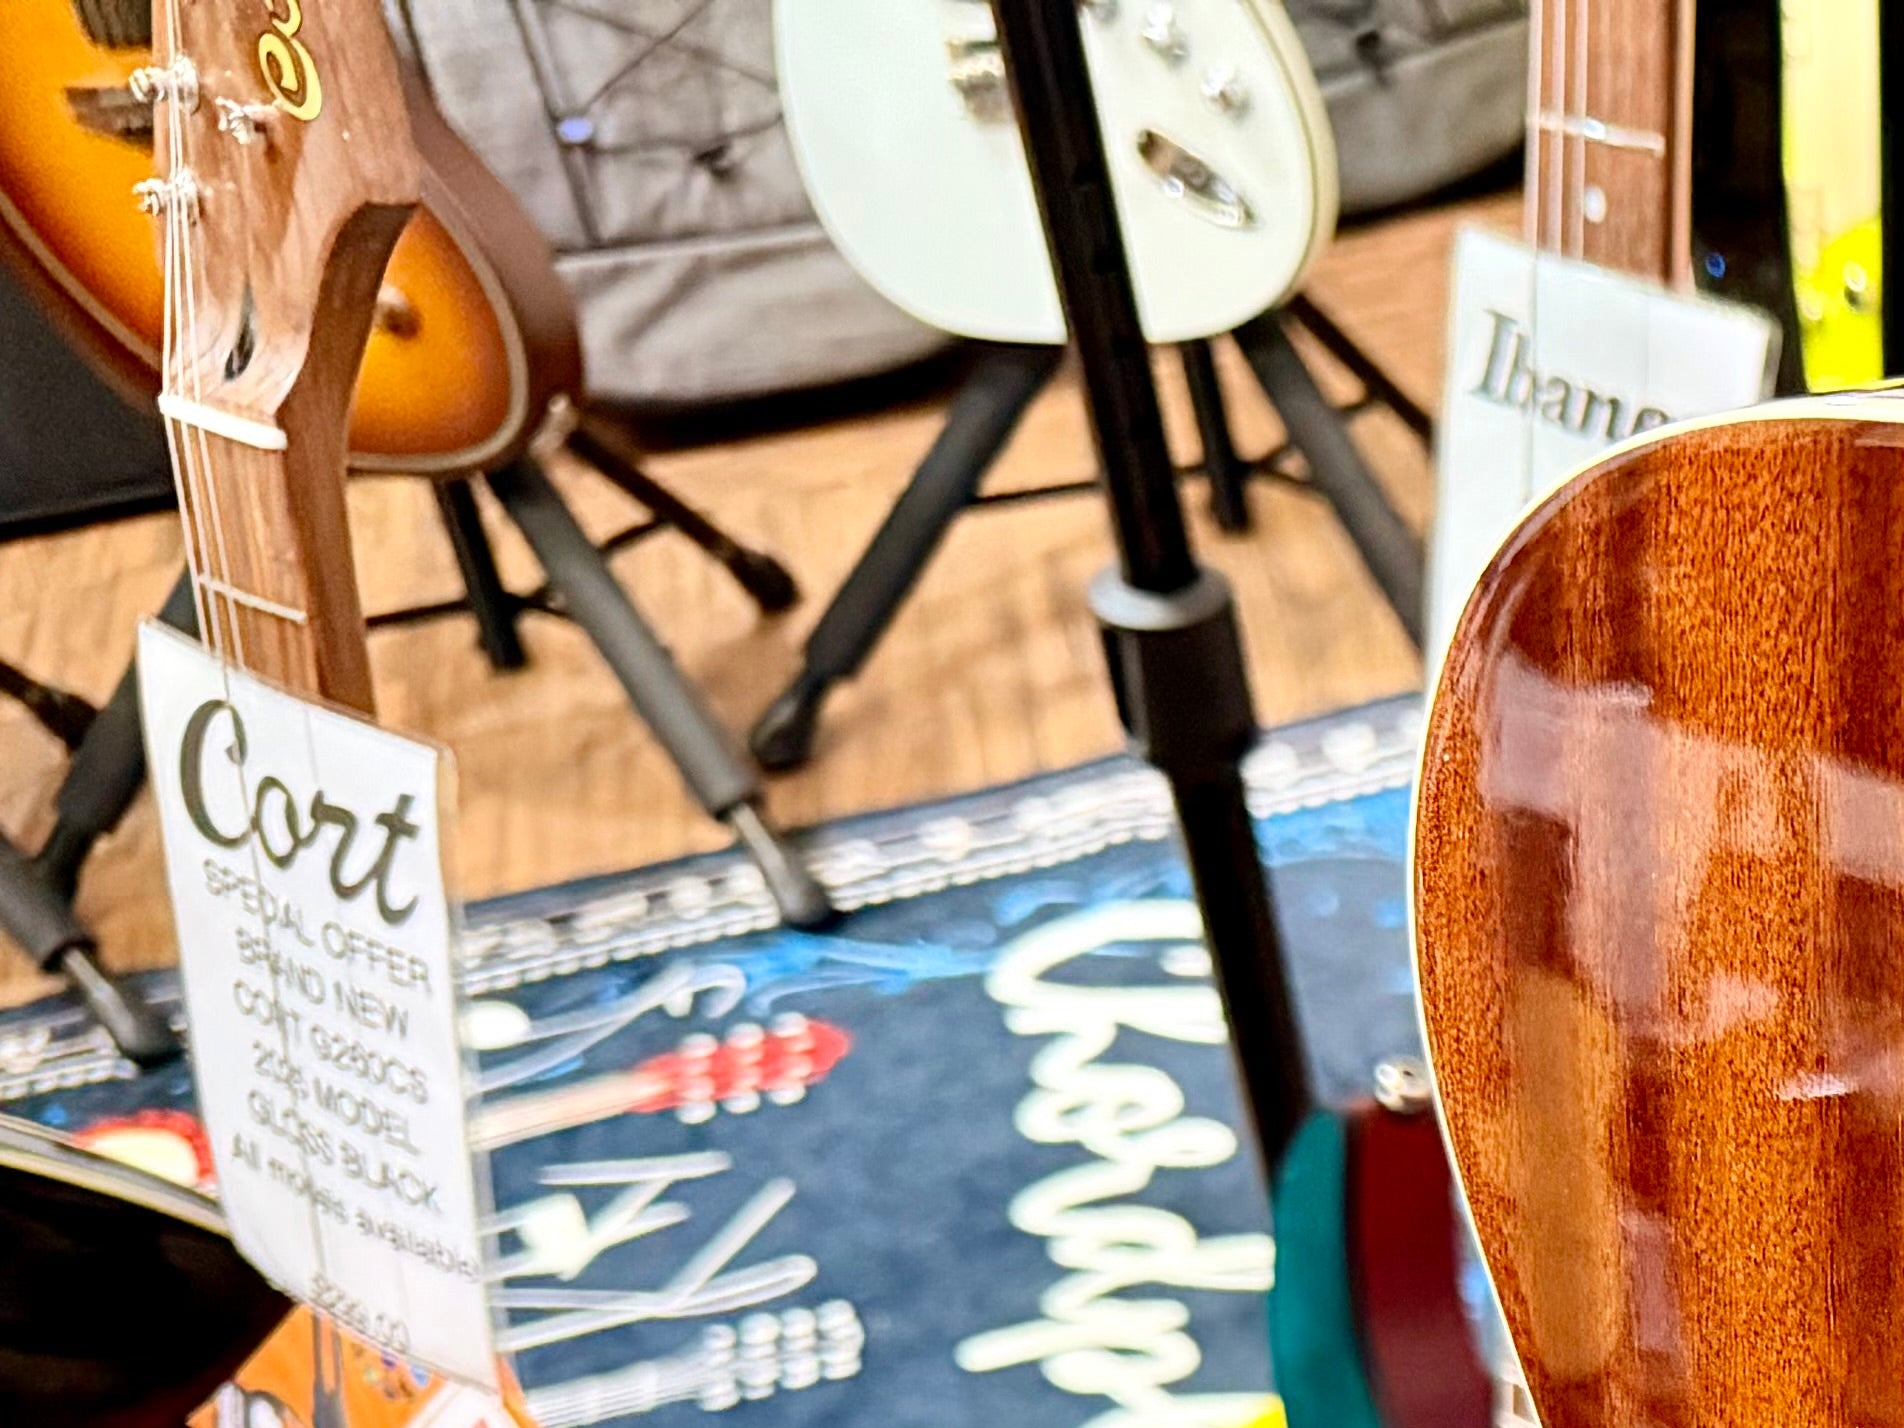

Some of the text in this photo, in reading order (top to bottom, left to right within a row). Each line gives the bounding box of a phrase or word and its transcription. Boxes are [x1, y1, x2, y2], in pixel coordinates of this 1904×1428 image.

[1469, 309, 1670, 442] Iban
[180, 699, 420, 924] Cort
[321, 921, 432, 997] OFFER
[333, 981, 409, 1040] NEW
[313, 1077, 421, 1155] MODEL
[340, 1140, 442, 1215] BLACK
